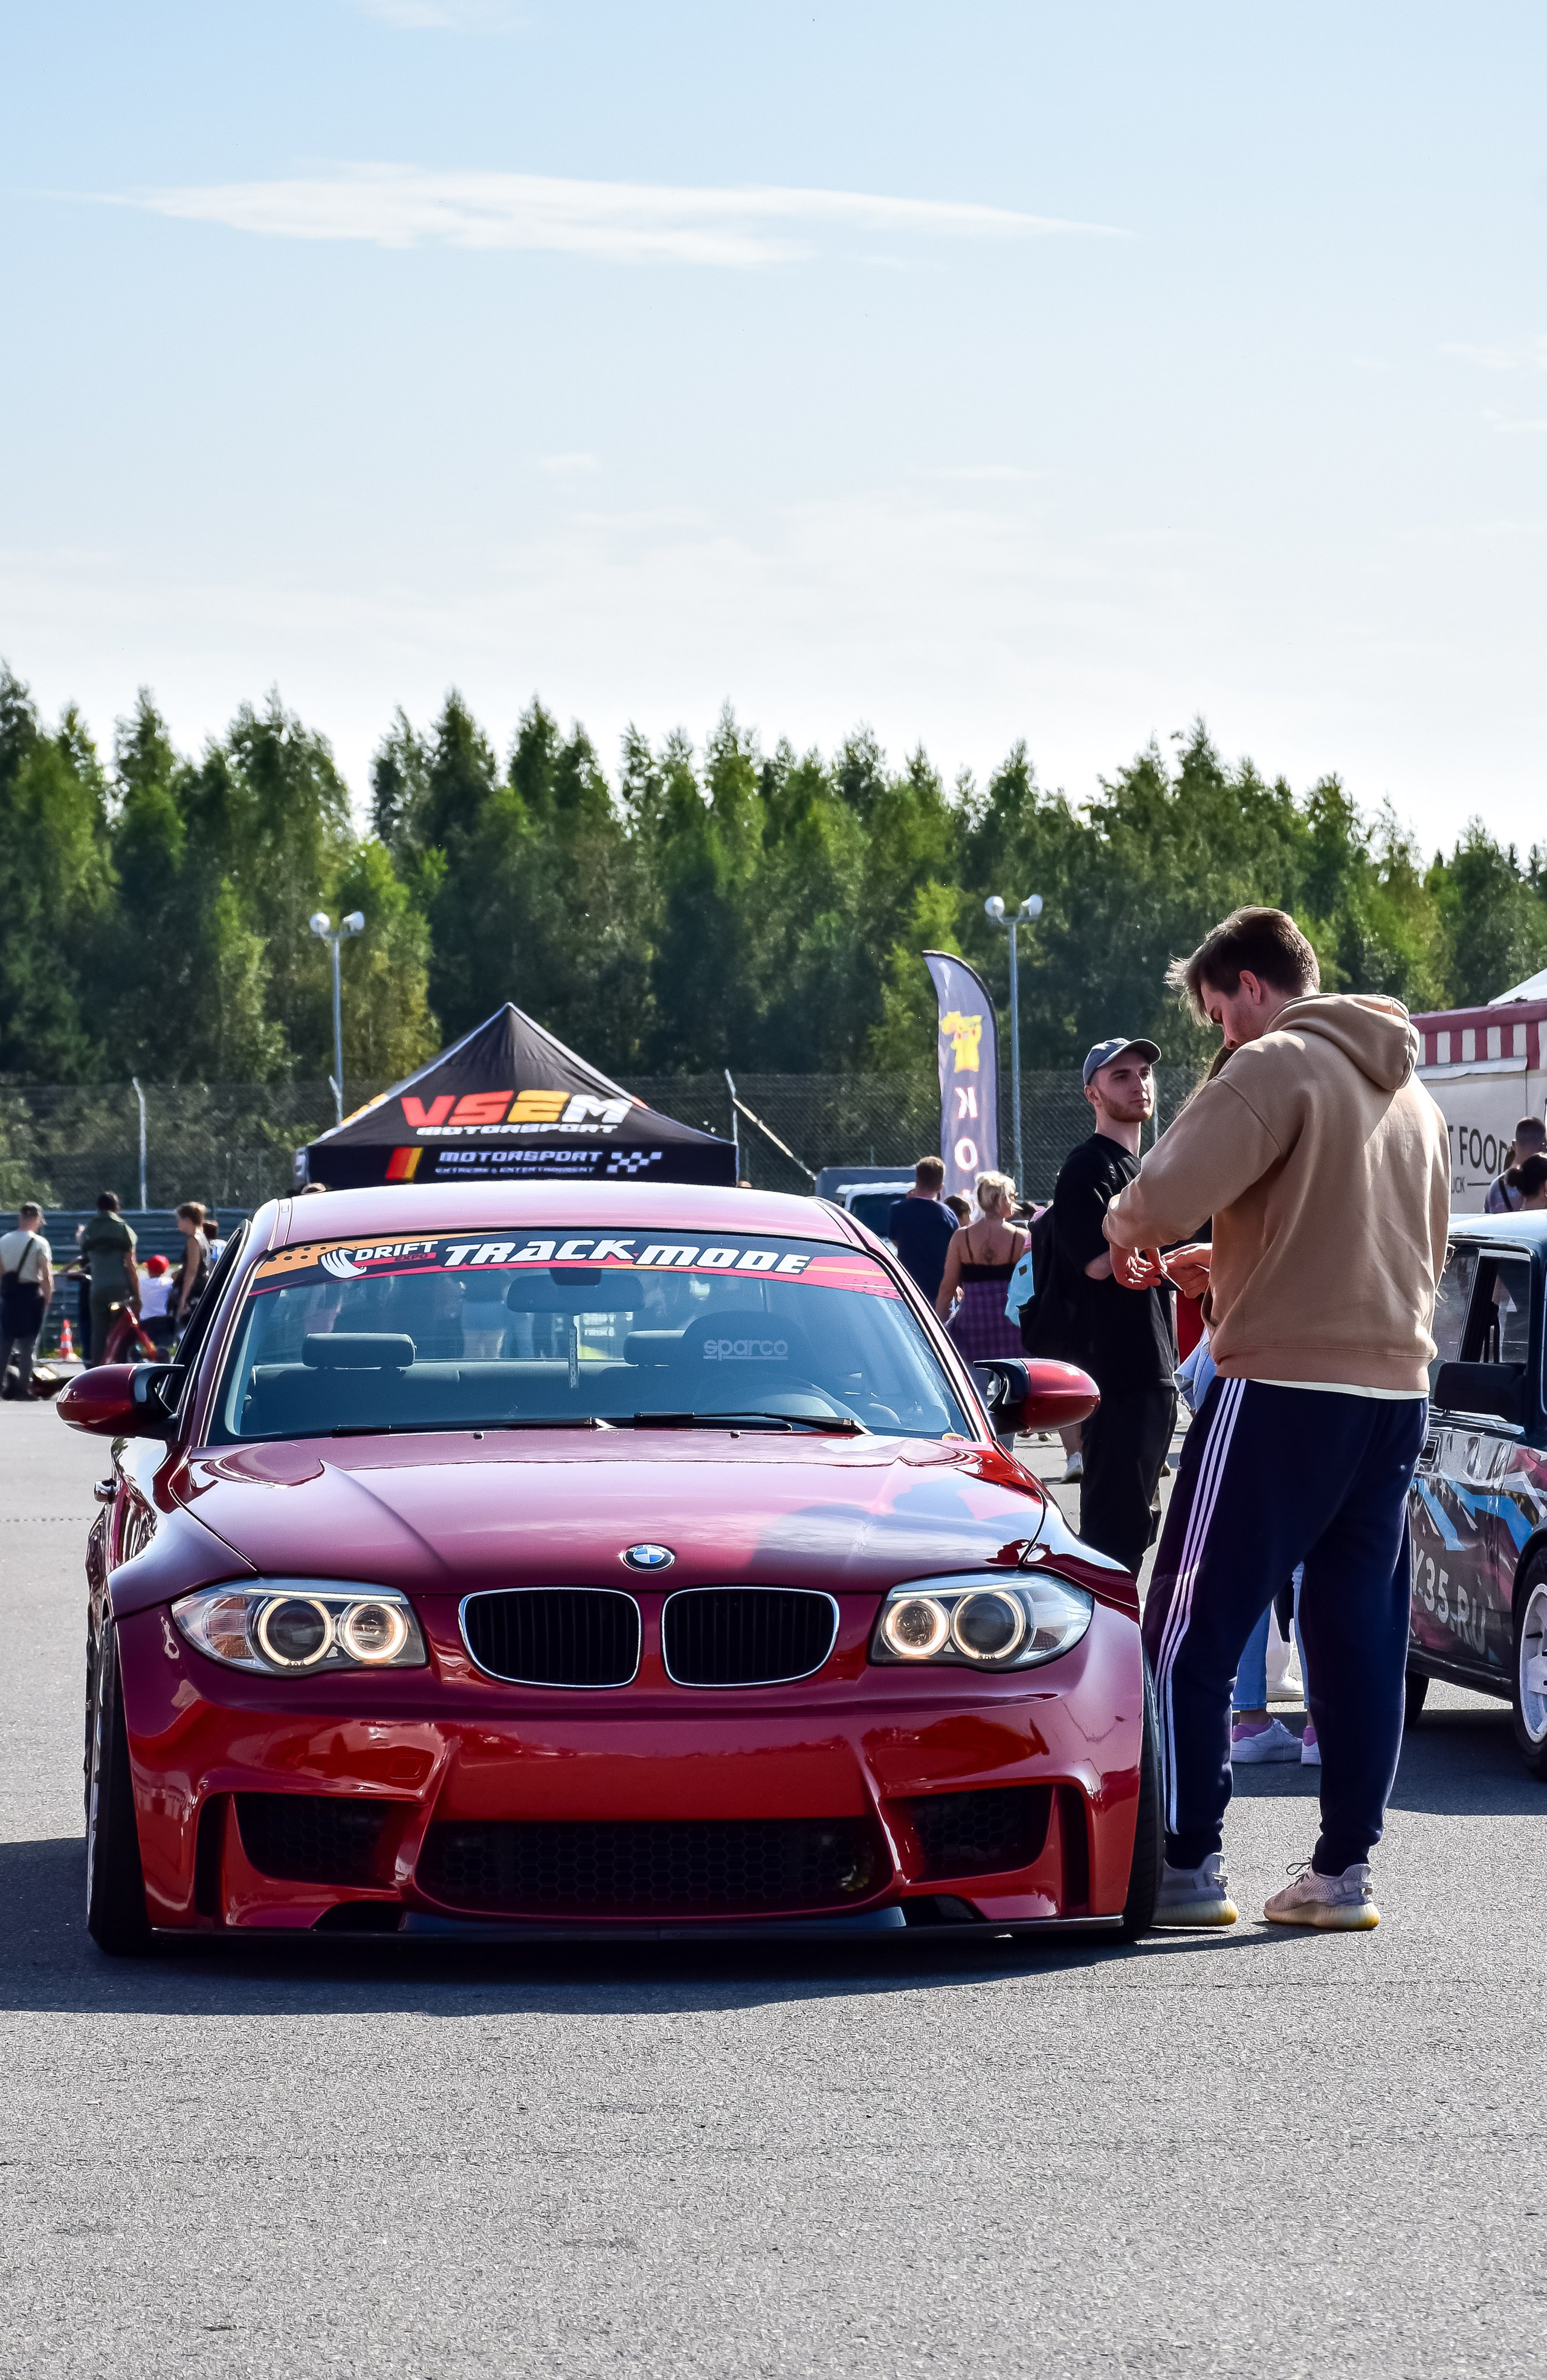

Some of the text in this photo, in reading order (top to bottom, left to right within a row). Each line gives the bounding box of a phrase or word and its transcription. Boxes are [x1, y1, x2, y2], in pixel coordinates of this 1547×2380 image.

[416, 1124, 618, 1136] MOTORSPORT
[439, 1151, 602, 1163] MOTORSPORT
[355, 1241, 439, 1261] DRIFT
[444, 1240, 811, 1275] TRACK MODE
[703, 1339, 788, 1361] sparco
